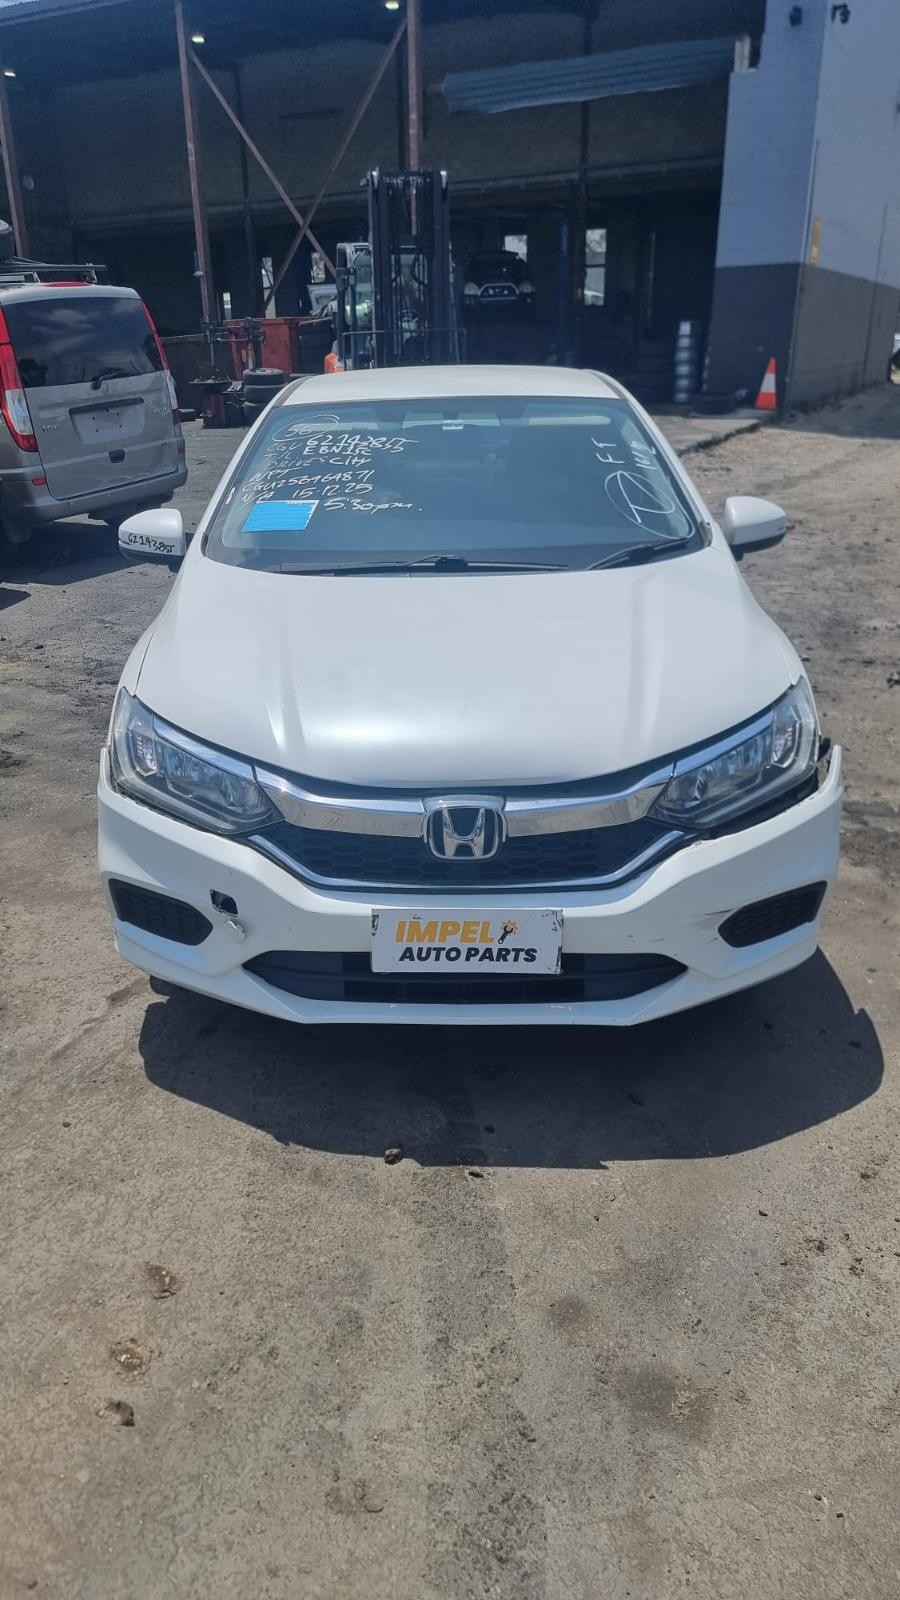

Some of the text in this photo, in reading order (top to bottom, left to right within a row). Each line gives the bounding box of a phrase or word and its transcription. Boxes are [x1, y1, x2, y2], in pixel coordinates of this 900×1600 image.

[394, 919, 495, 945] IMPEL
[398, 946, 538, 963] AUTO PARTS
